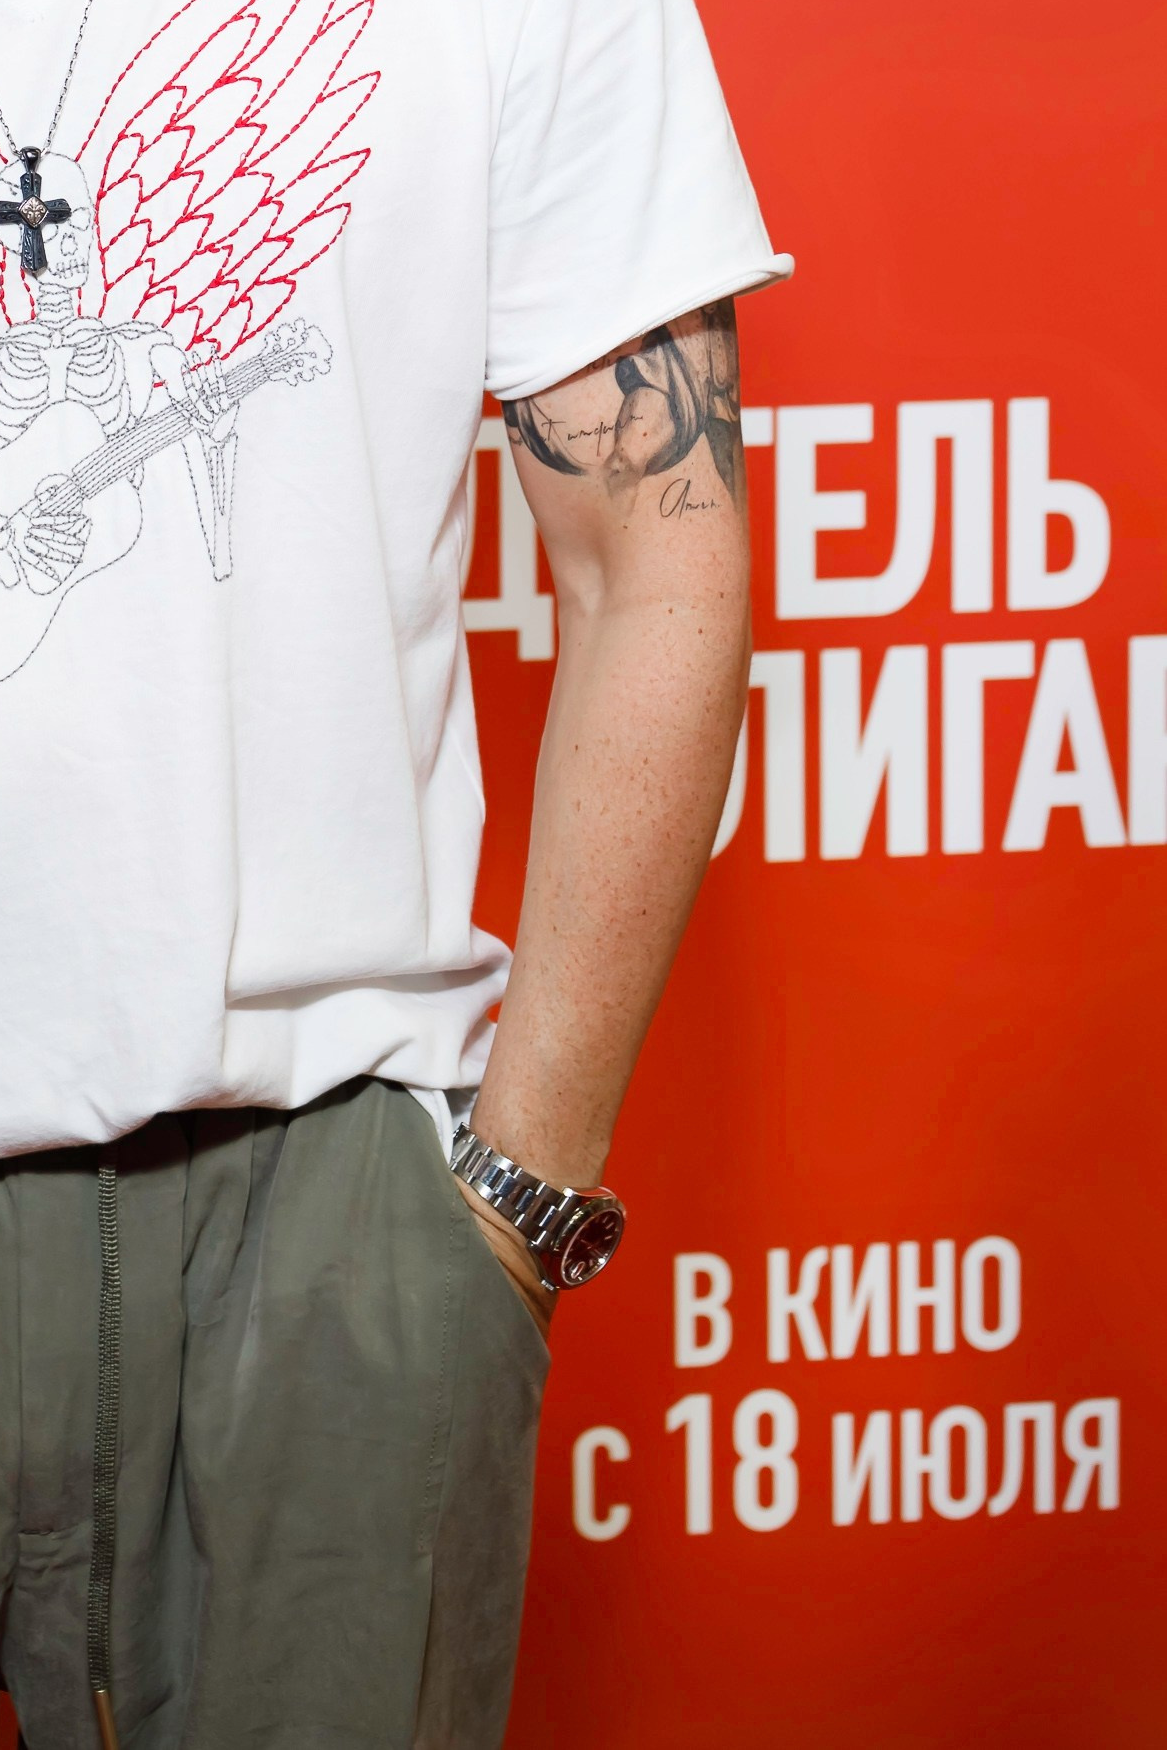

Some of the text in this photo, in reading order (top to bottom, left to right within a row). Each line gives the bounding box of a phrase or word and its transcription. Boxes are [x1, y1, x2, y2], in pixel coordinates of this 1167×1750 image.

[673, 1235, 1021, 1368] В КИНО
[665, 1388, 799, 1535] 18
[832, 1397, 1120, 1526] ИЮЛЯ
